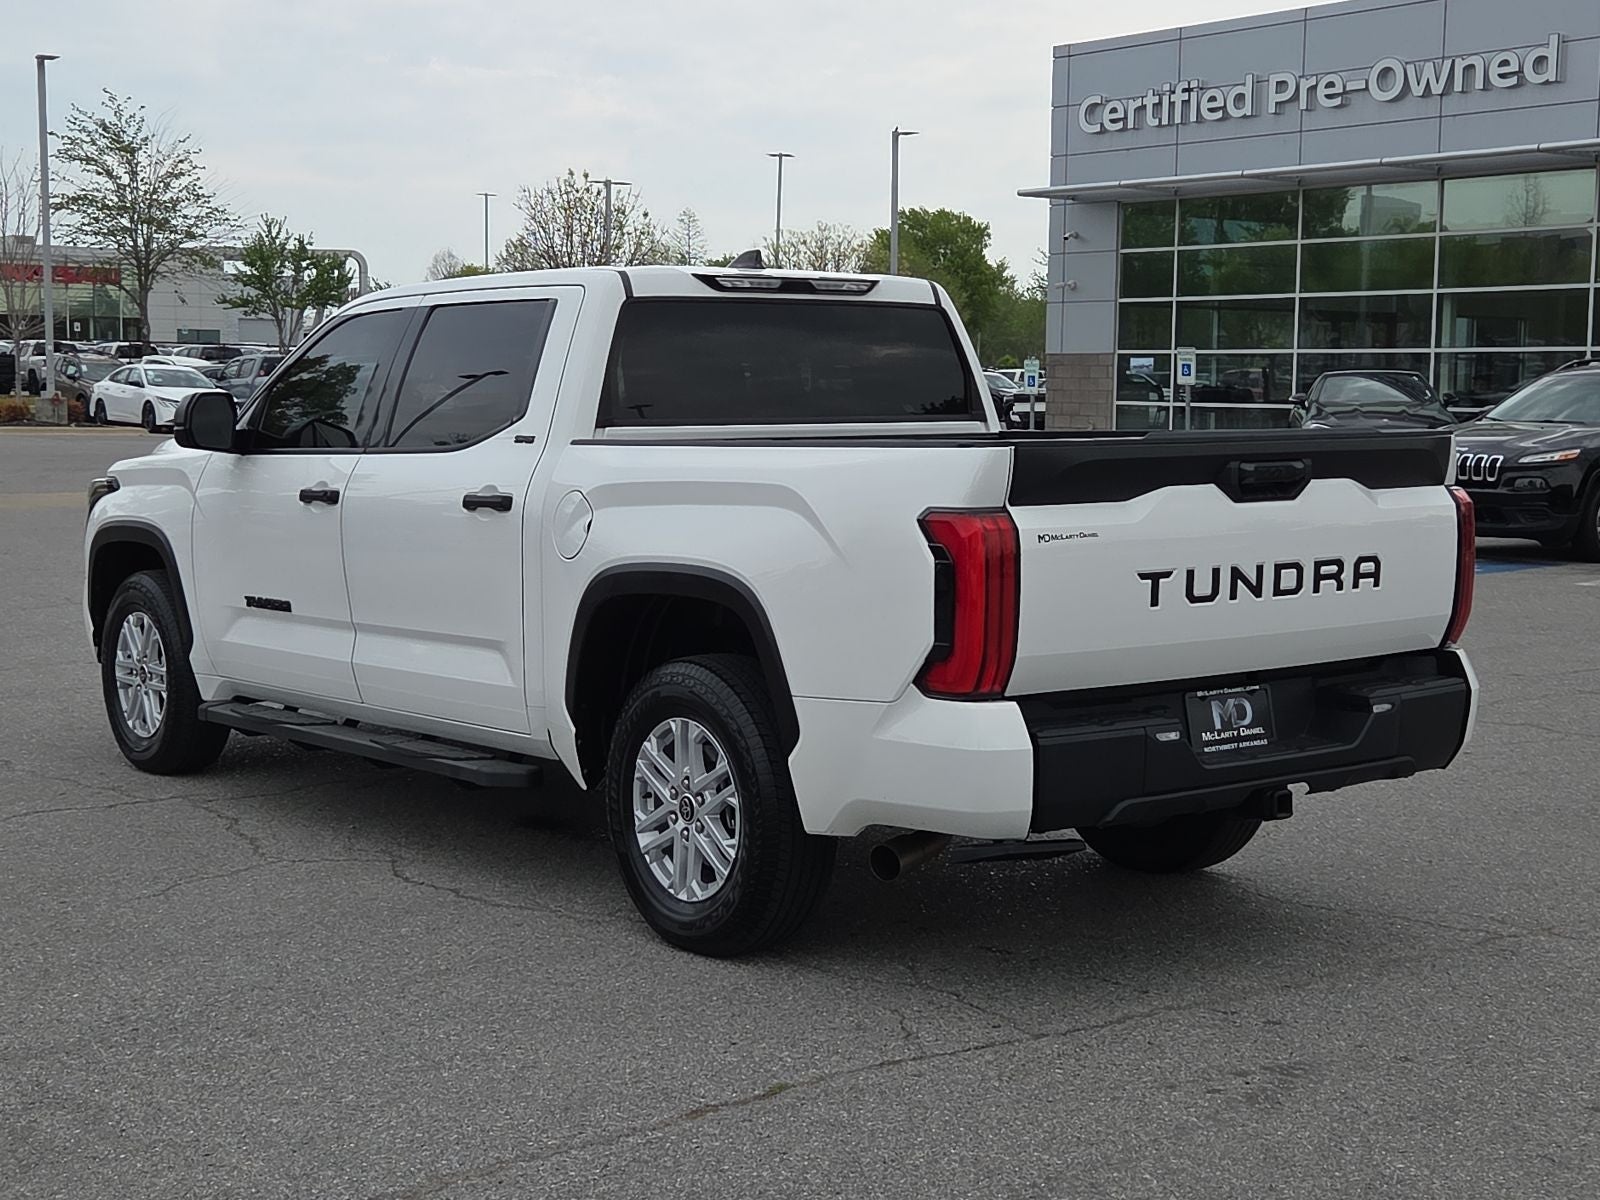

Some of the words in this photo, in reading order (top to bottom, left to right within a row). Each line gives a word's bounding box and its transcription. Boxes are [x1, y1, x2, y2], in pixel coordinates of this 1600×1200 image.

[1078, 73, 1255, 134] Certified
[1267, 32, 1564, 115] Pre-Owned
[1135, 553, 1383, 609] TUNDRA
[1210, 697, 1253, 730] MD
